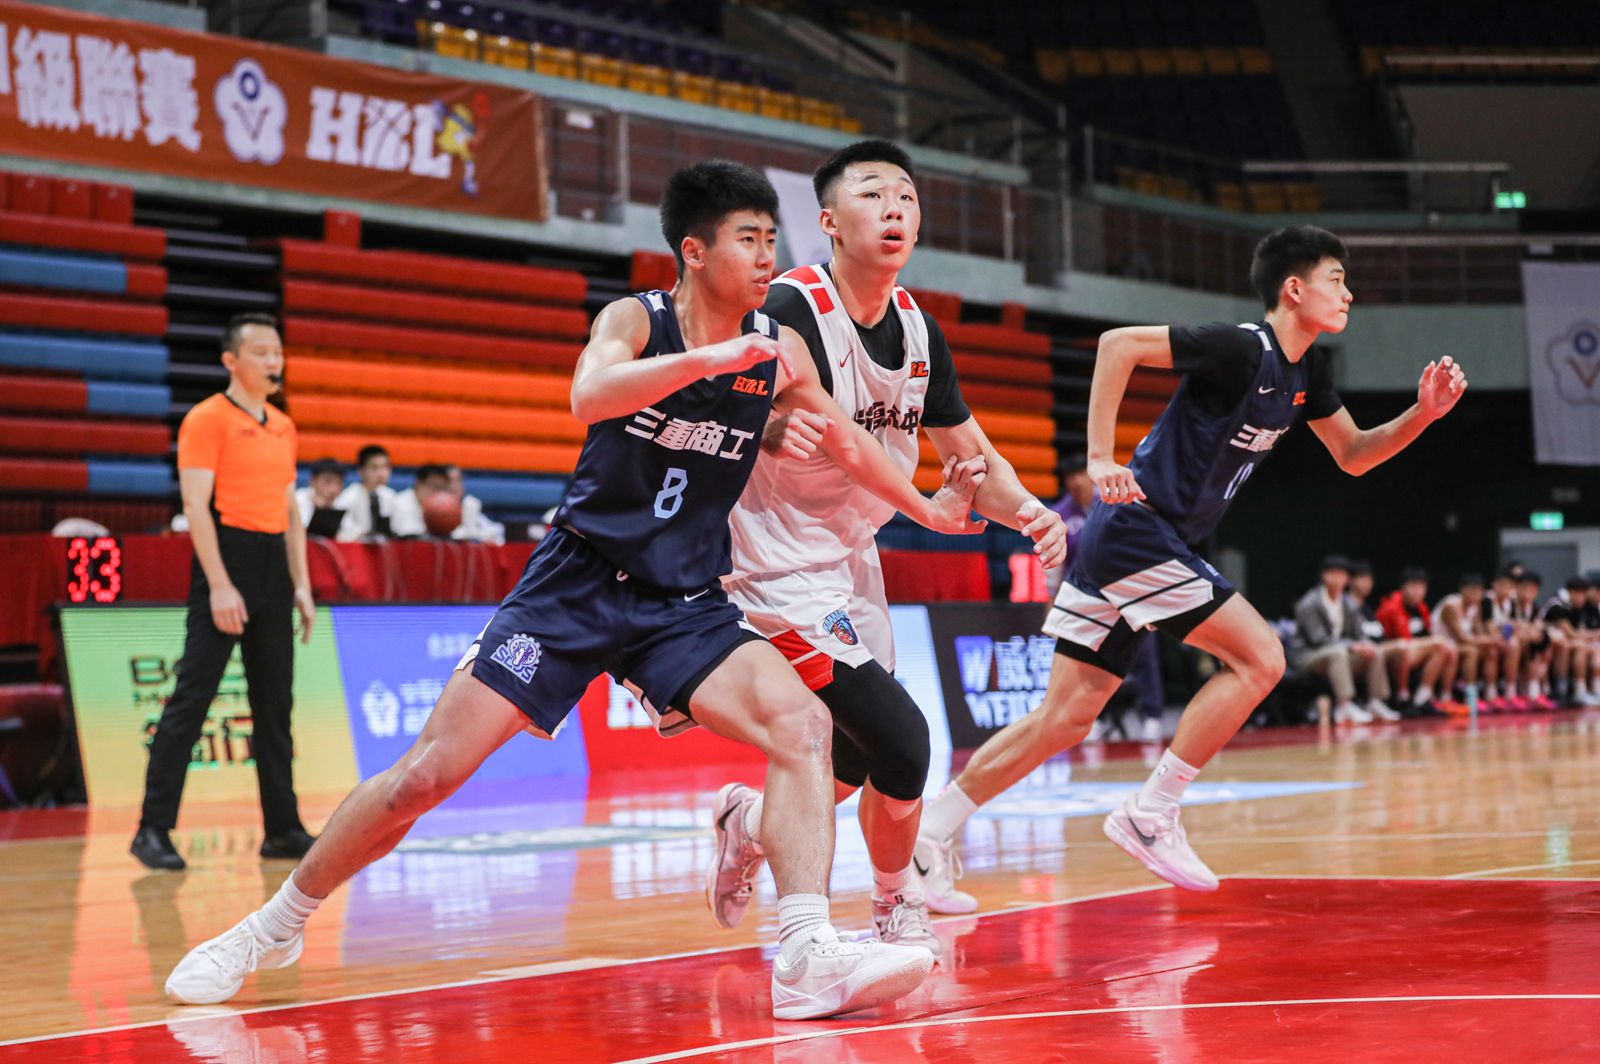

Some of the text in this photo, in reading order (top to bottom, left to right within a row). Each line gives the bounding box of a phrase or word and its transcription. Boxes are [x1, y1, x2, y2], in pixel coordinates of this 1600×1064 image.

[0, 22, 202, 153] 級聯賽
[306, 86, 453, 181] HBL
[732, 375, 769, 396] HBL
[624, 406, 756, 461] 三重商工
[653, 467, 689, 519] 8
[68, 537, 121, 602] 33
